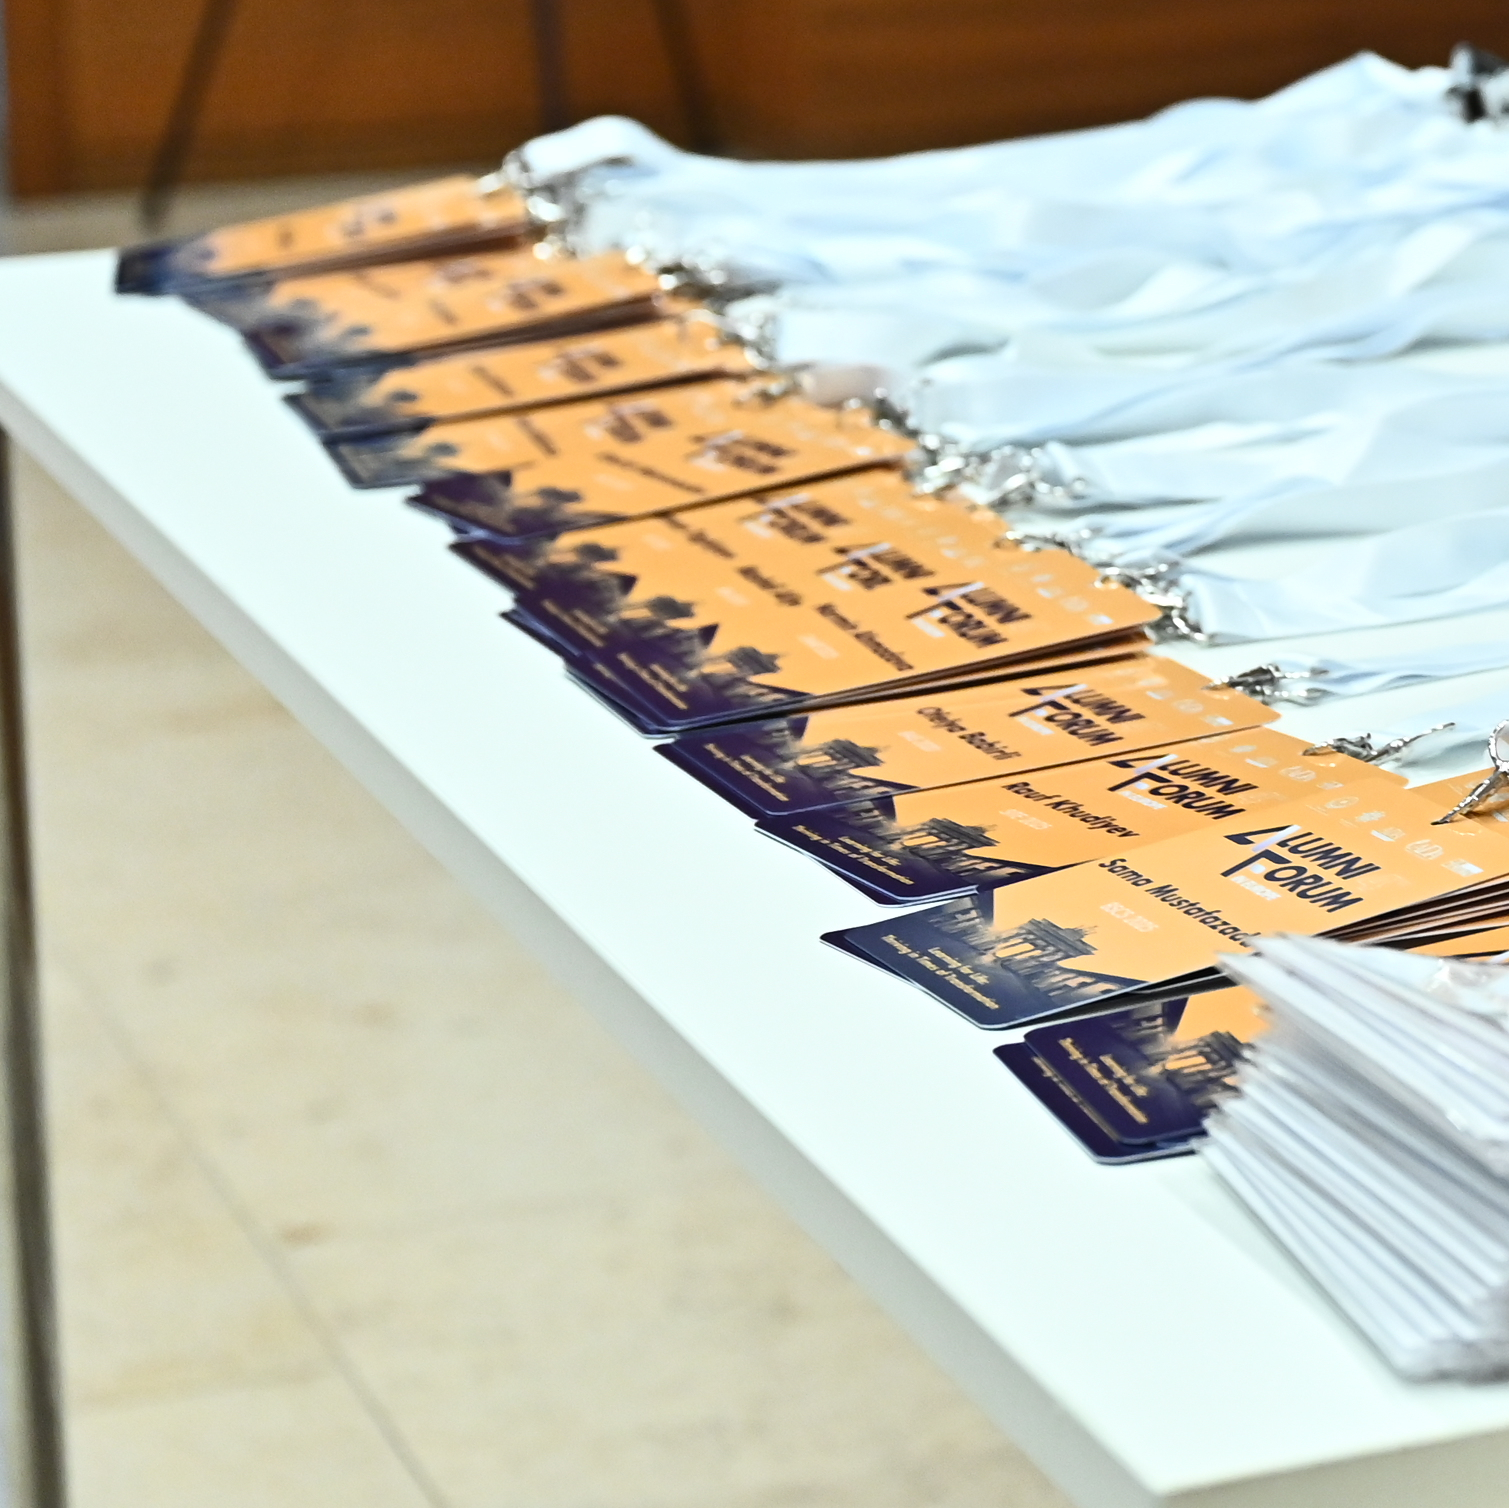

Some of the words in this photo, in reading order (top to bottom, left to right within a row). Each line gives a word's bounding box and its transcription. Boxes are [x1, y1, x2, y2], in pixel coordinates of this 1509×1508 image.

[1007, 700, 1124, 747] FORUM
[1106, 753, 1259, 796] ALUMNI
[1106, 771, 1246, 820] FORUM
[1001, 782, 1062, 807] Rauf
[1044, 796, 1140, 838] Khudiyev
[1222, 823, 1382, 881] ALUMNI
[1098, 858, 1154, 888] Sama
[1145, 883, 1262, 948] Mustafazad
[1219, 848, 1365, 914] FORUM
